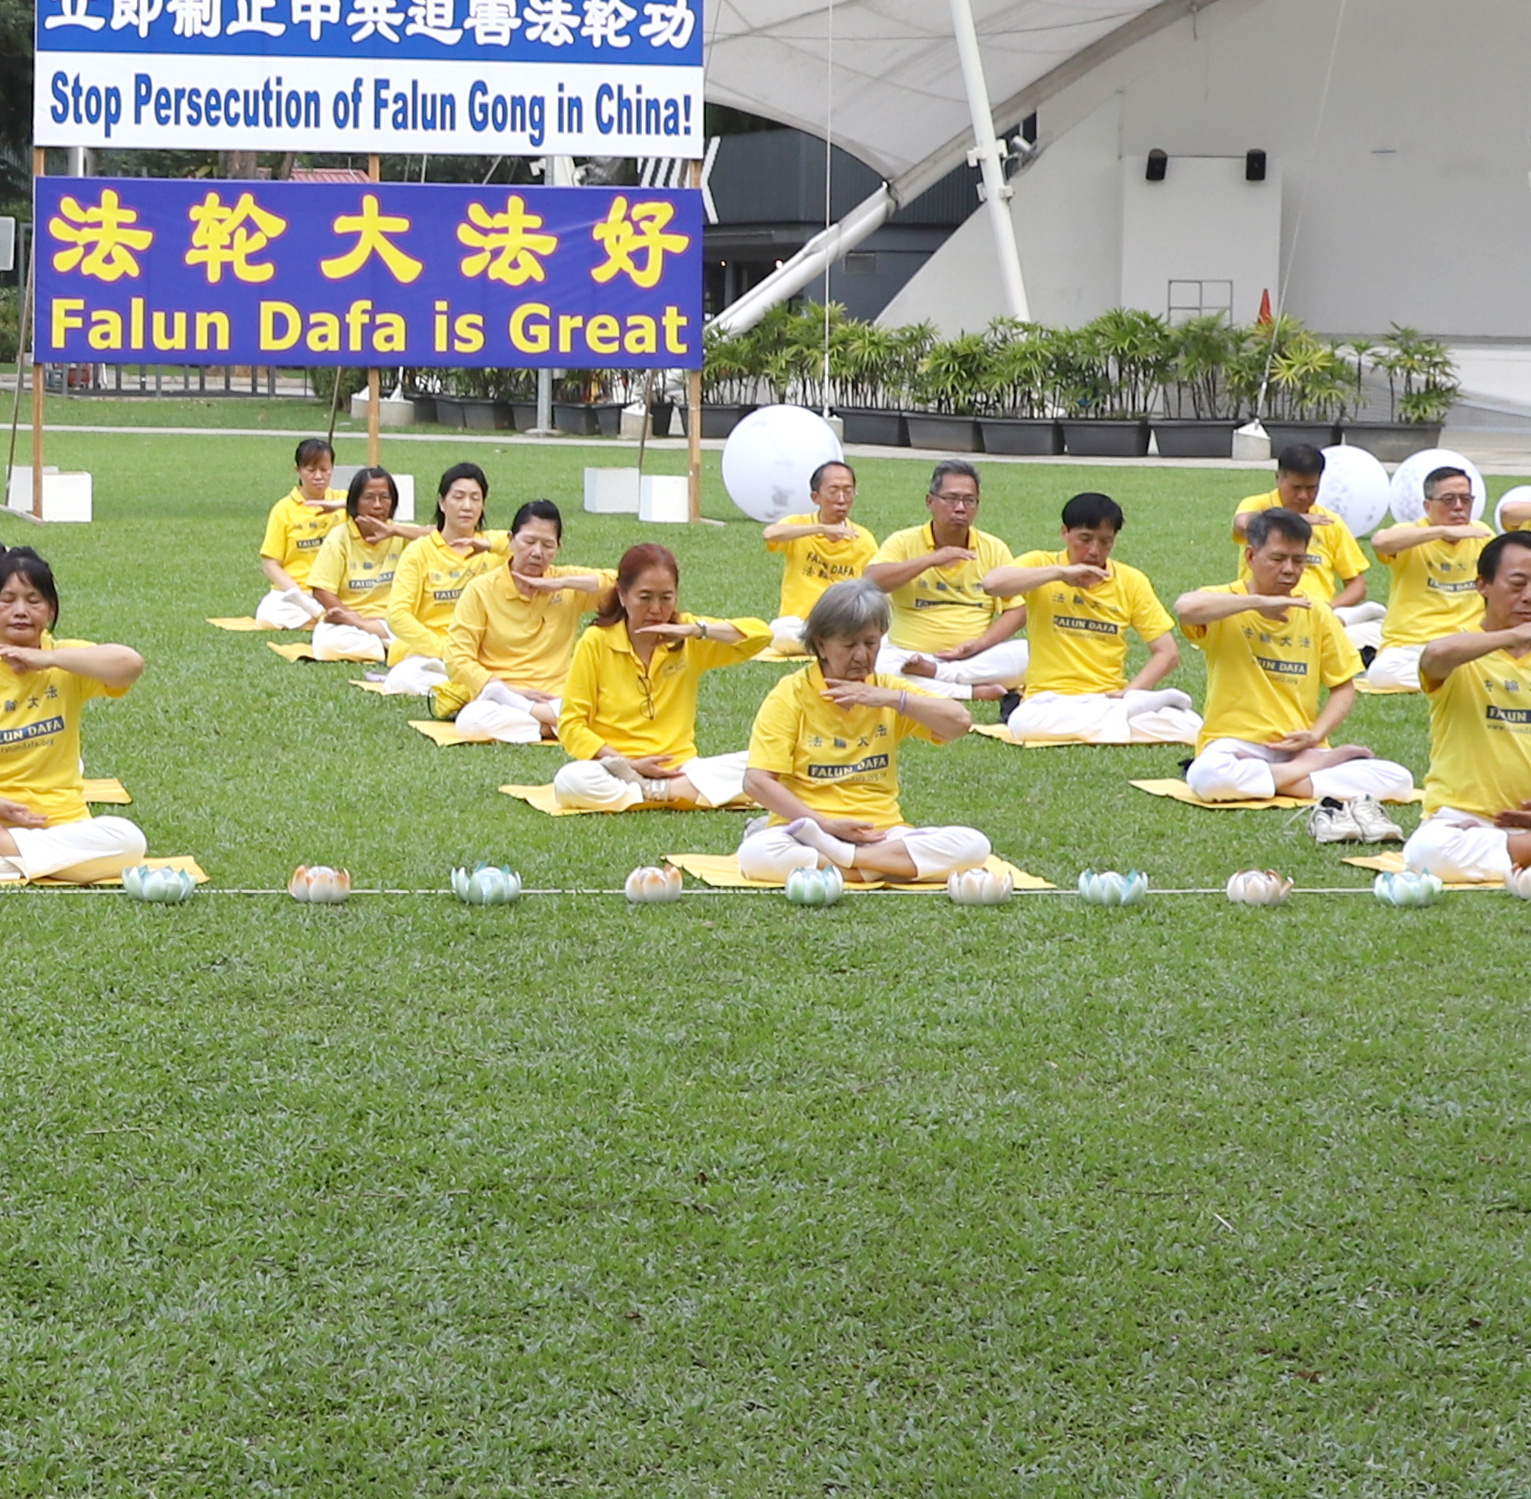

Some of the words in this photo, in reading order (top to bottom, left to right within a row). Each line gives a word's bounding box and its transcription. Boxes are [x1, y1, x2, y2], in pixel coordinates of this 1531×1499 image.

[51, 70, 122, 138] Stop
[134, 71, 321, 131] Persecution
[333, 77, 363, 131] of
[374, 78, 457, 132] Falun
[469, 79, 545, 147] Gong
[557, 81, 583, 134] in
[595, 82, 692, 135] China!
[48, 189, 691, 288] 法轮大法好
[51, 297, 230, 351] Falun
[259, 299, 407, 354] Dafa
[435, 301, 485, 355] is
[510, 305, 688, 356] Great
[436, 589, 462, 600] FALU
[1088, 622, 1117, 634] DAFA
[1278, 662, 1306, 673] DAFA
[27, 719, 62, 737] DAFA
[811, 765, 855, 778] FALUN
[856, 755, 888, 772] DAFA
